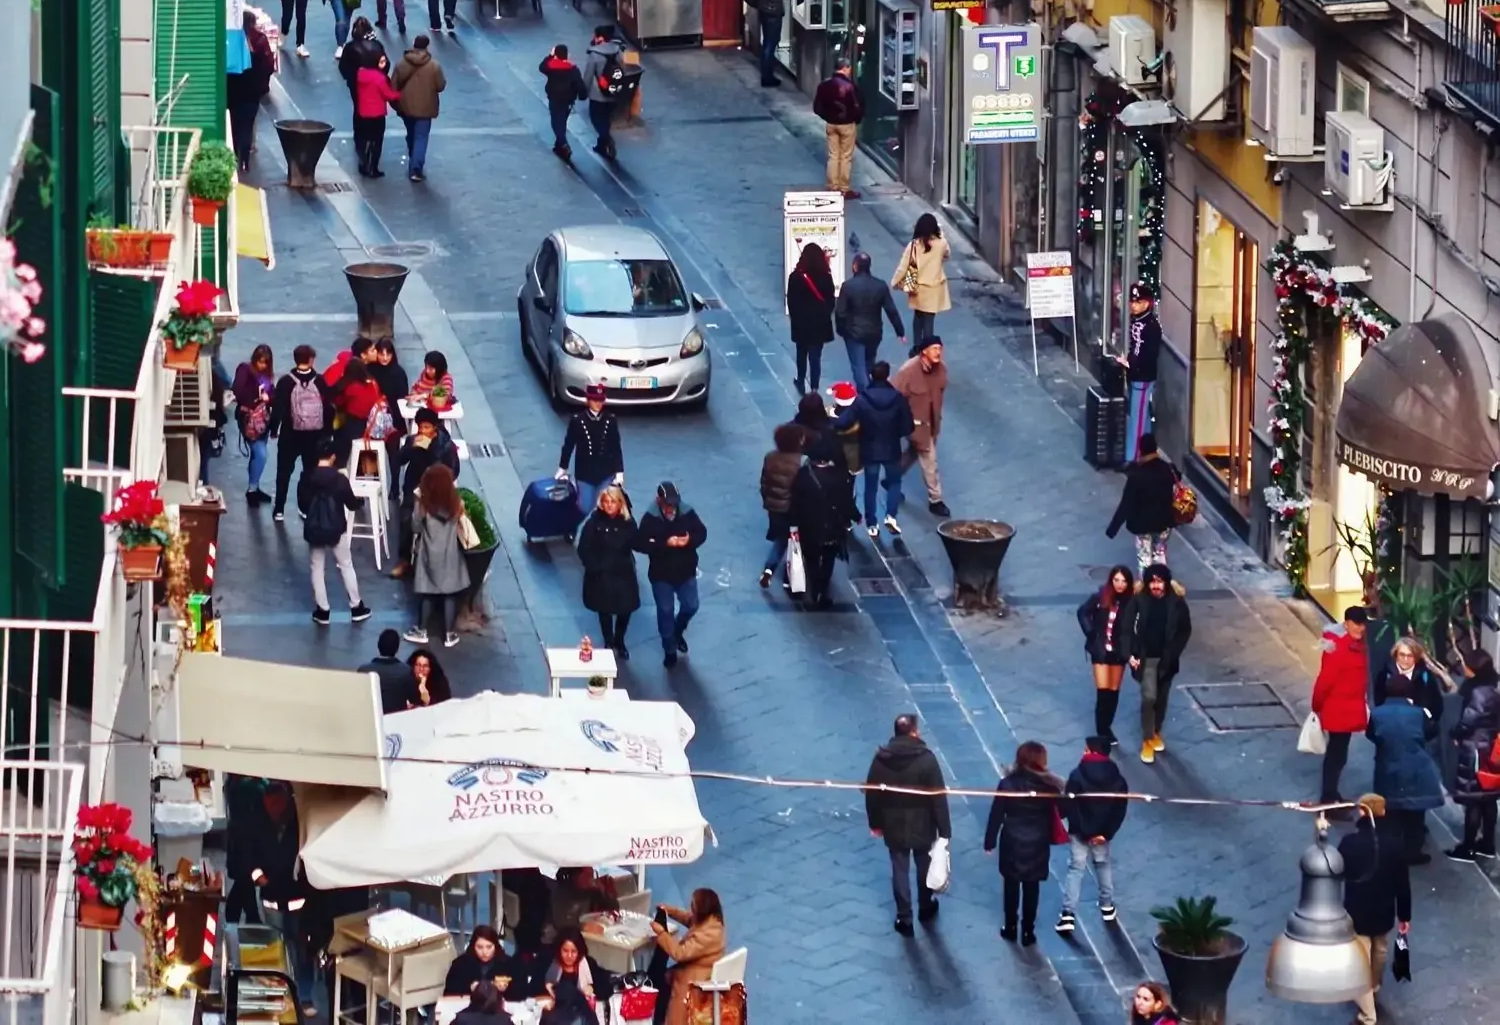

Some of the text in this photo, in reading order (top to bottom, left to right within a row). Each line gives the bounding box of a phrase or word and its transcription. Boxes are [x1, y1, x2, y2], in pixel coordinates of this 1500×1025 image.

[1344, 444, 1422, 483] PLEBISCITO
[455, 790, 544, 808] NASTRO
[448, 803, 554, 823] AZZURRO
[630, 836, 684, 849] NASTRO
[625, 848, 688, 860] AZZURRO
